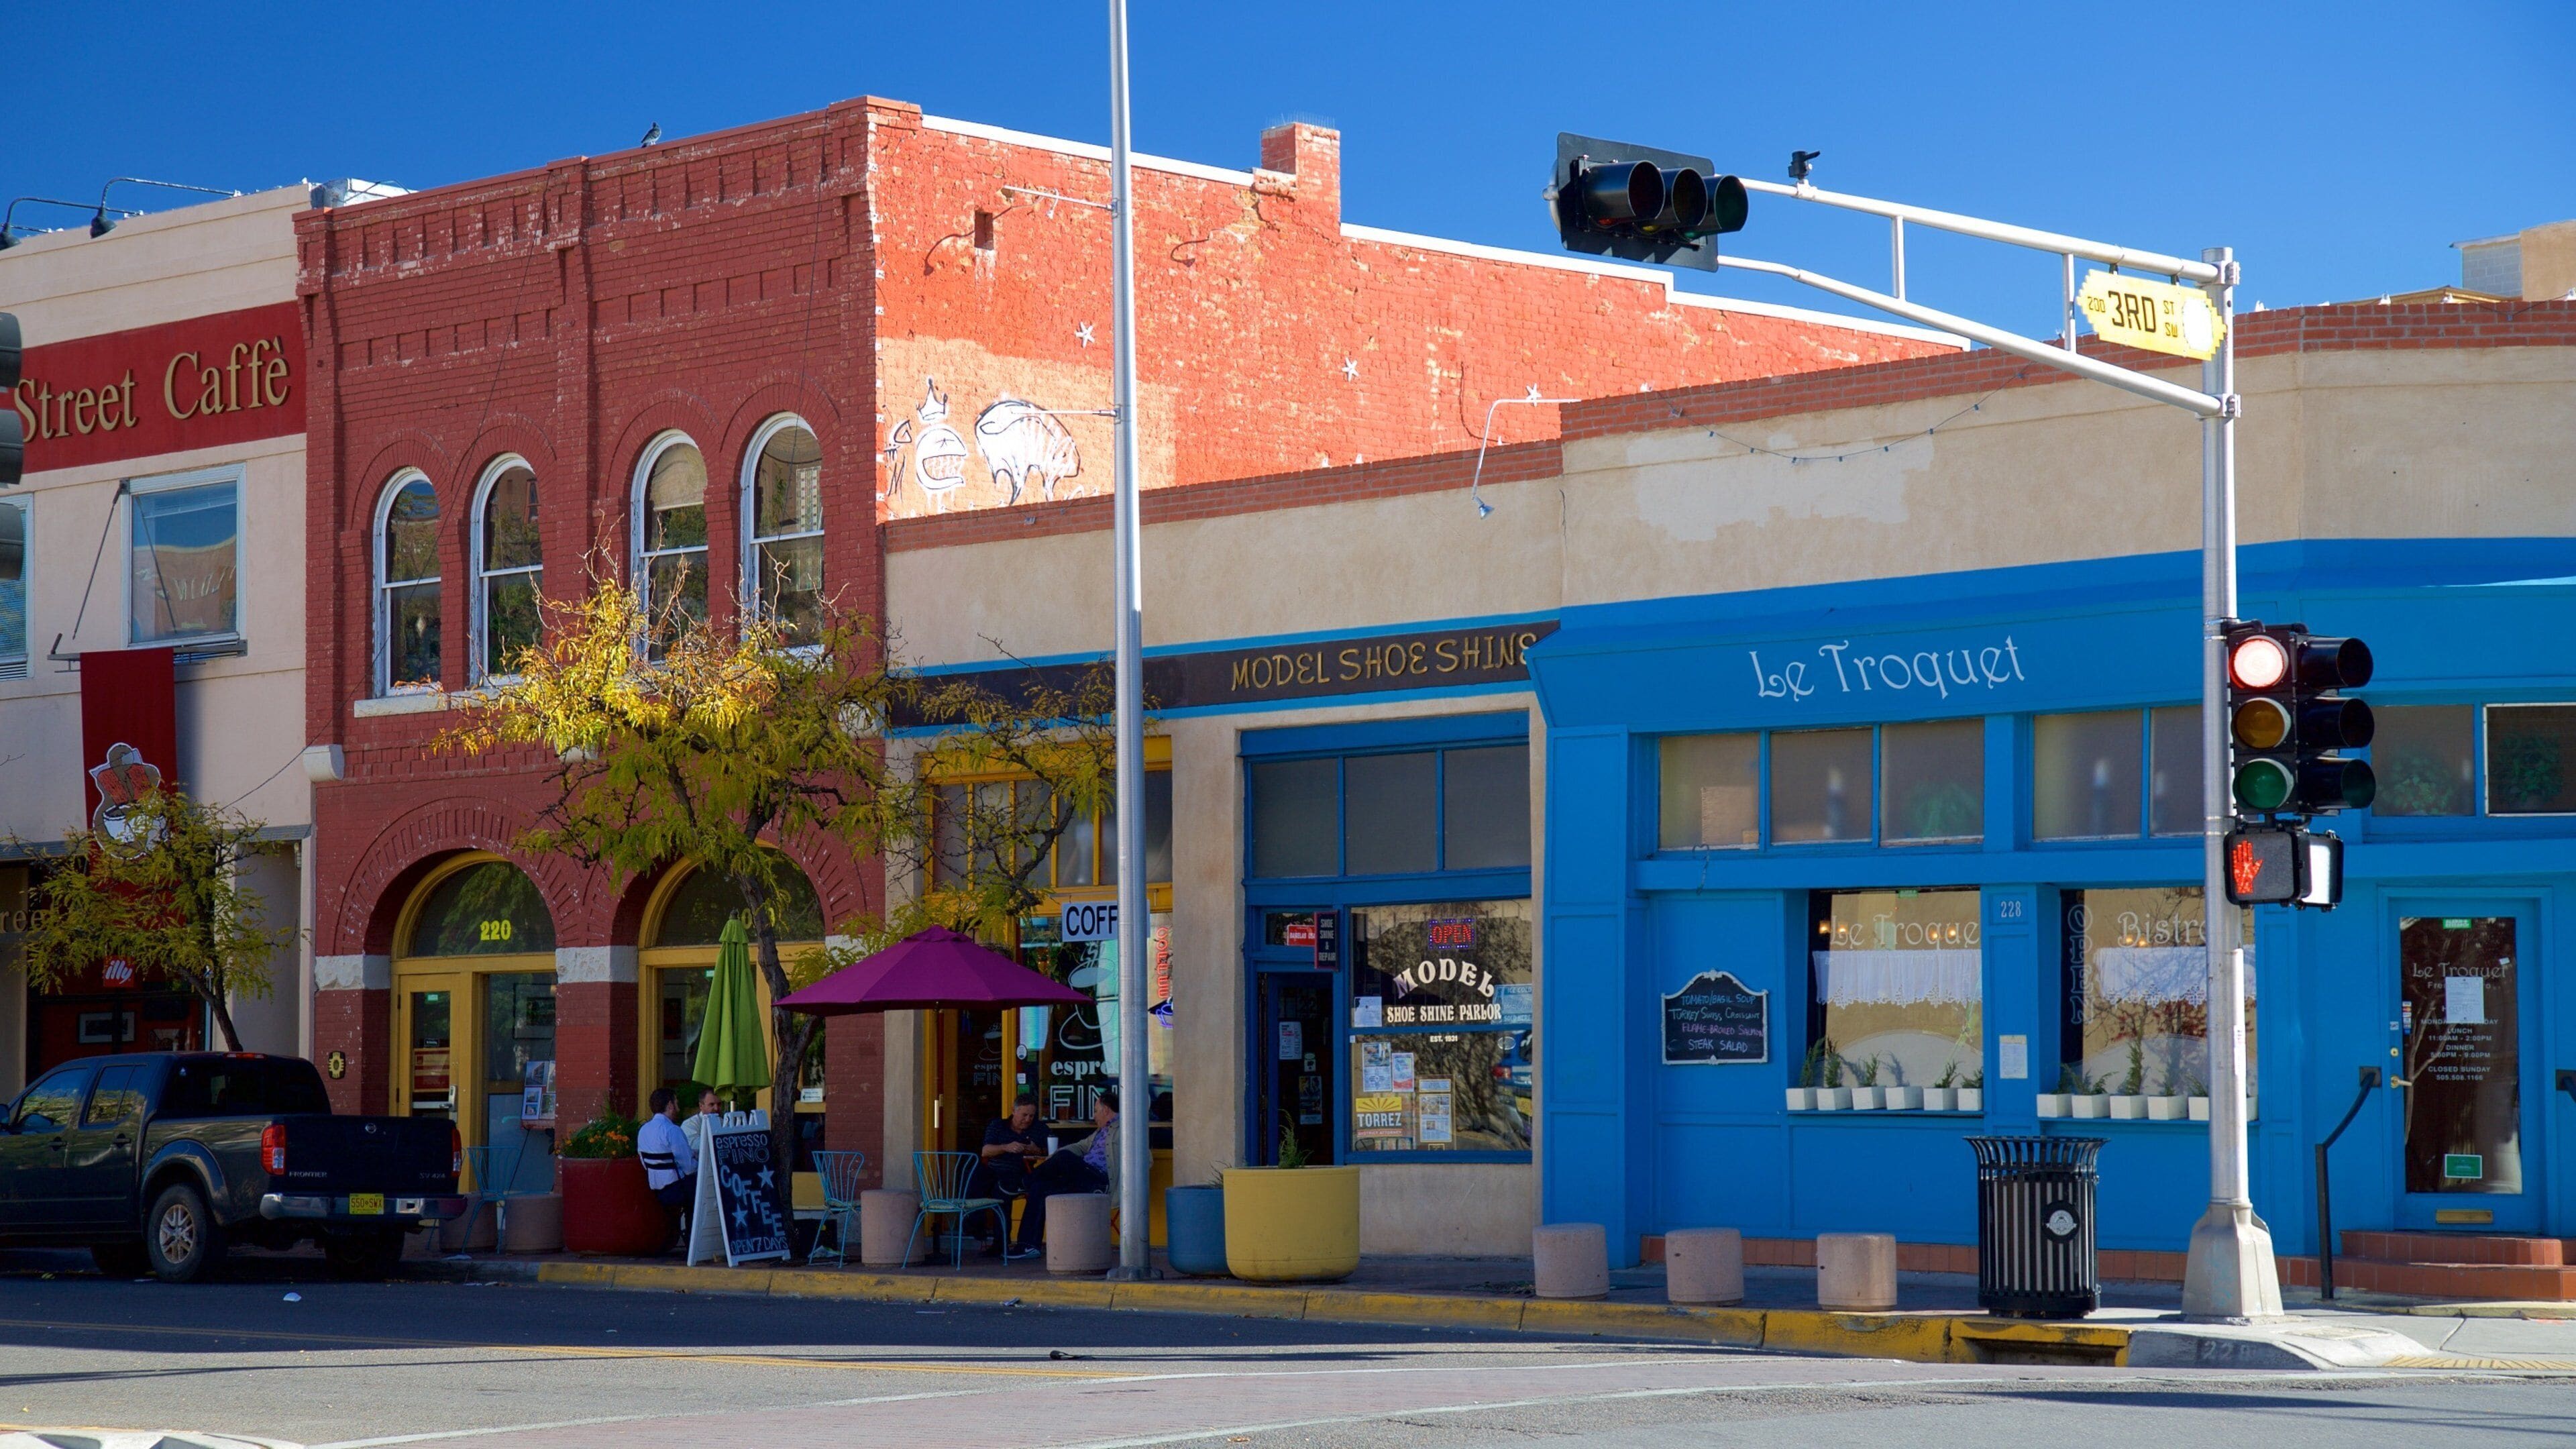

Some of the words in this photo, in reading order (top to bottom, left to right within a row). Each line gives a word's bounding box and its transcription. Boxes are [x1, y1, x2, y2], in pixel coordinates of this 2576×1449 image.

[2088, 296, 2105, 313] 200
[2108, 290, 2156, 333] 3RD
[2163, 301, 2175, 315] ST
[2165, 323, 2178, 337] SW
[15, 369, 139, 442] Street
[164, 336, 289, 419] Caffè
[1232, 651, 1330, 692] MODEL
[1340, 643, 1428, 681] SHOE
[1749, 651, 1814, 702] Le
[1819, 635, 2025, 700] Troquet
[2000, 901, 2021, 918] 228
[1066, 905, 1118, 936] COFF
[1320, 919, 1334, 928] SHOE
[480, 920, 511, 941] 220
[1320, 930, 1334, 938] SHINE
[1433, 924, 1471, 944] OPEN
[1831, 915, 1865, 949] Le
[1873, 912, 1979, 950] Troque
[1325, 941, 1329, 950] &
[1319, 952, 1336, 961] REPAIR
[2068, 904, 2095, 1024] OPEN
[105, 960, 133, 984] illy
[1393, 958, 1495, 999] MODEL
[2413, 963, 2434, 979] Le
[1735, 994, 1756, 1004] SOUP
[1387, 1006, 1415, 1022] SHOE
[1420, 1005, 1454, 1022] SHINE
[1460, 1004, 1501, 1020] PARLOR
[1688, 1039, 1714, 1051] STEAK
[1720, 1040, 1748, 1053] SALAD
[1051, 1060, 1114, 1080] espre
[1050, 1085, 1118, 1120] FIN
[1357, 1113, 1402, 1127] TORREZ
[716, 1133, 768, 1149] espresso
[717, 1147, 770, 1165] FINO
[720, 1165, 786, 1237] COFFEE
[731, 1240, 753, 1254] OPEN
[752, 1237, 762, 1252] 7
[763, 1236, 789, 1250] DAYS
